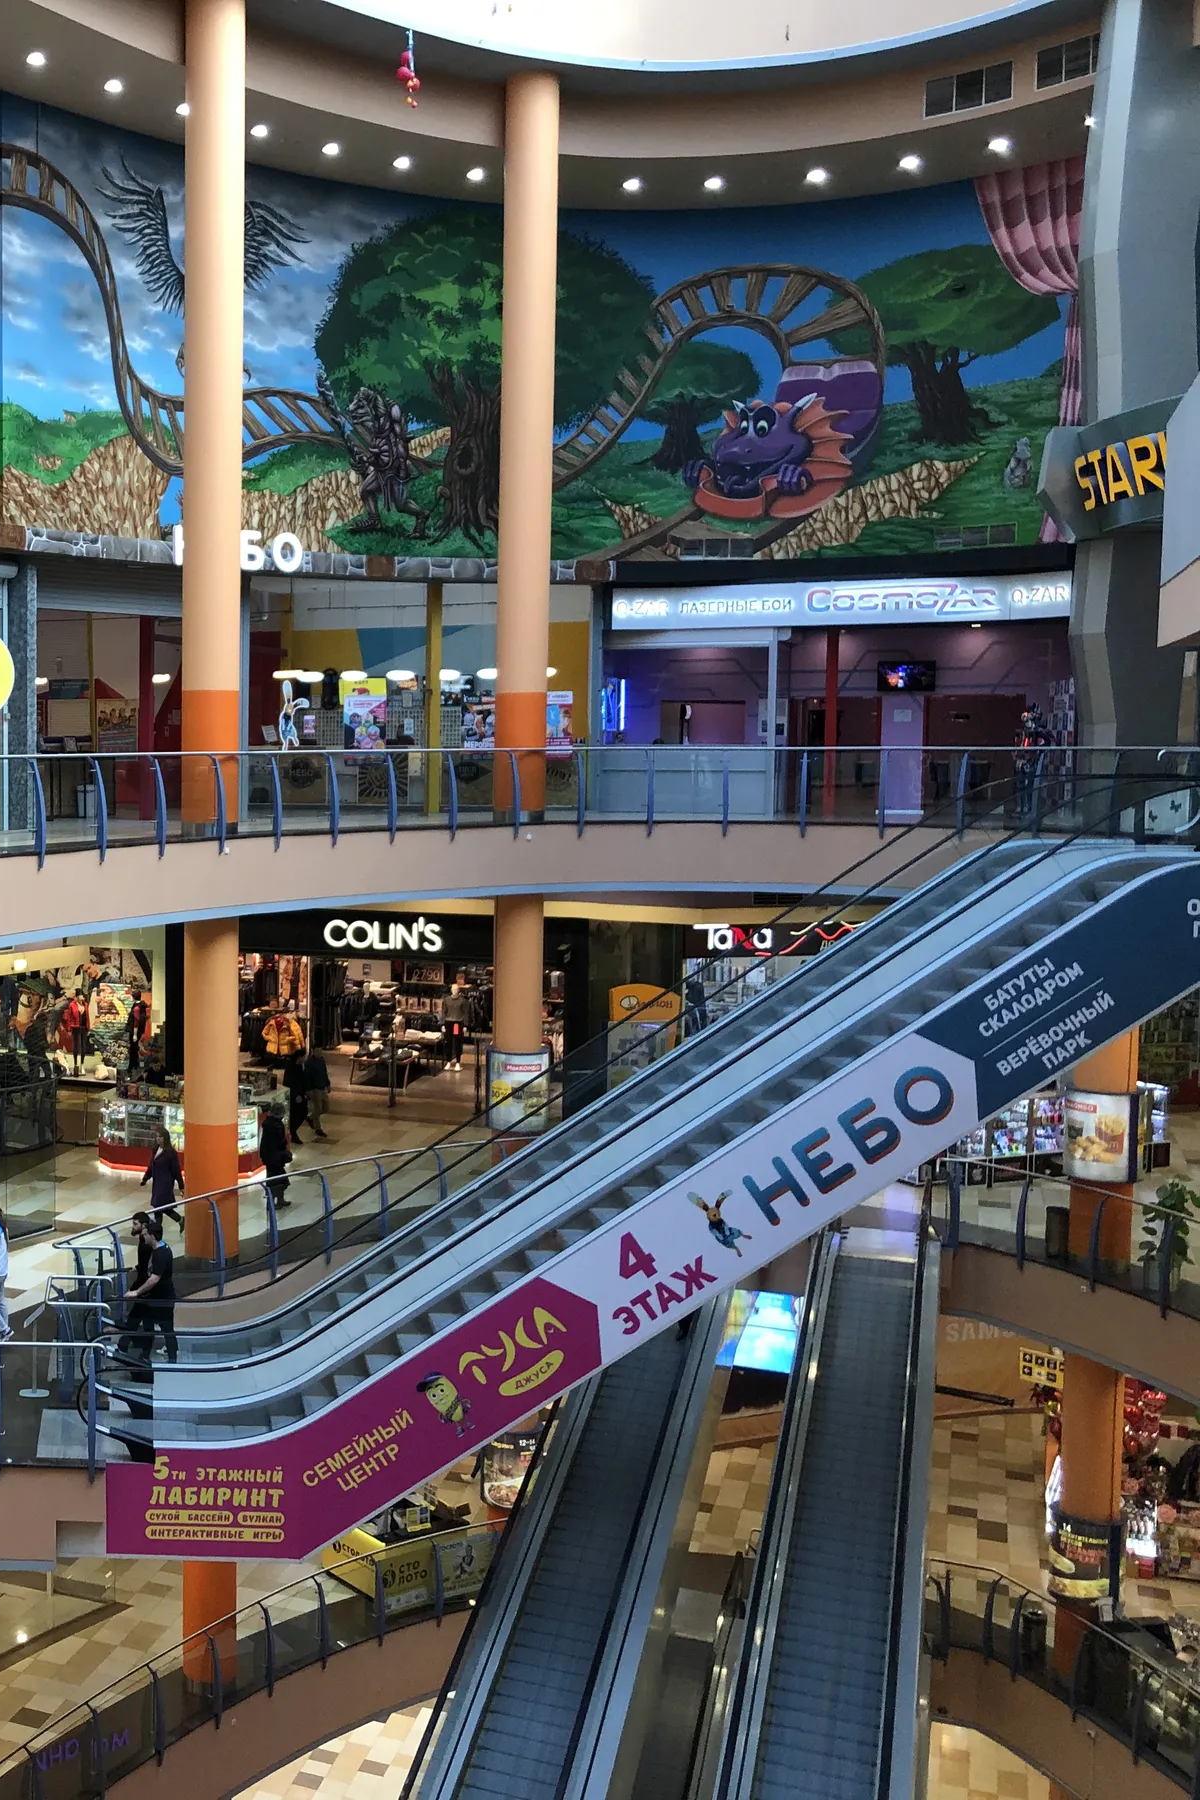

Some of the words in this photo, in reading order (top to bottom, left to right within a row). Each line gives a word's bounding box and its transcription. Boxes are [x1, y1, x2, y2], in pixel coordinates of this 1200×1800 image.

[1074, 431, 1168, 511] STAR
[616, 600, 669, 617] Q-ZAR
[679, 599, 757, 615] ЛАЗЕРНЫЕ
[1010, 585, 1068, 606] Q-ZAR
[323, 916, 442, 952] COLIN'S
[978, 961, 1085, 1037] СКАЛОДРОМ
[983, 957, 1055, 1011] БАТУТЫ
[996, 990, 1116, 1076] ВЕРЁВОЧНЫЙ
[1041, 1030, 1092, 1069] ПАРК
[742, 1066, 954, 1226] НЕБО
[619, 1232, 658, 1280] 4
[612, 1255, 718, 1335] ЭТАЖ
[458, 1307, 567, 1384] ТУСА
[514, 1360, 554, 1390] ДЖУСА
[302, 1407, 414, 1487] СЕМЕЙНЫЙ
[195, 1466, 284, 1483] ЭТАЖНЫЙ
[337, 1443, 400, 1492] ЦЕНТР
[150, 1486, 285, 1508] ЛАБИРИНТ
[150, 1511, 180, 1521] СУХОЙ
[187, 1512, 231, 1523] БАССЕЙН
[242, 1514, 282, 1524] ВУЛКАН
[150, 1528, 245, 1539] ИНТЕРАКТИВНЫЕ
[253, 1531, 282, 1540] ИГРЫ
[398, 1560, 420, 1574] СТО
[398, 1569, 428, 1587] ЛОТО
